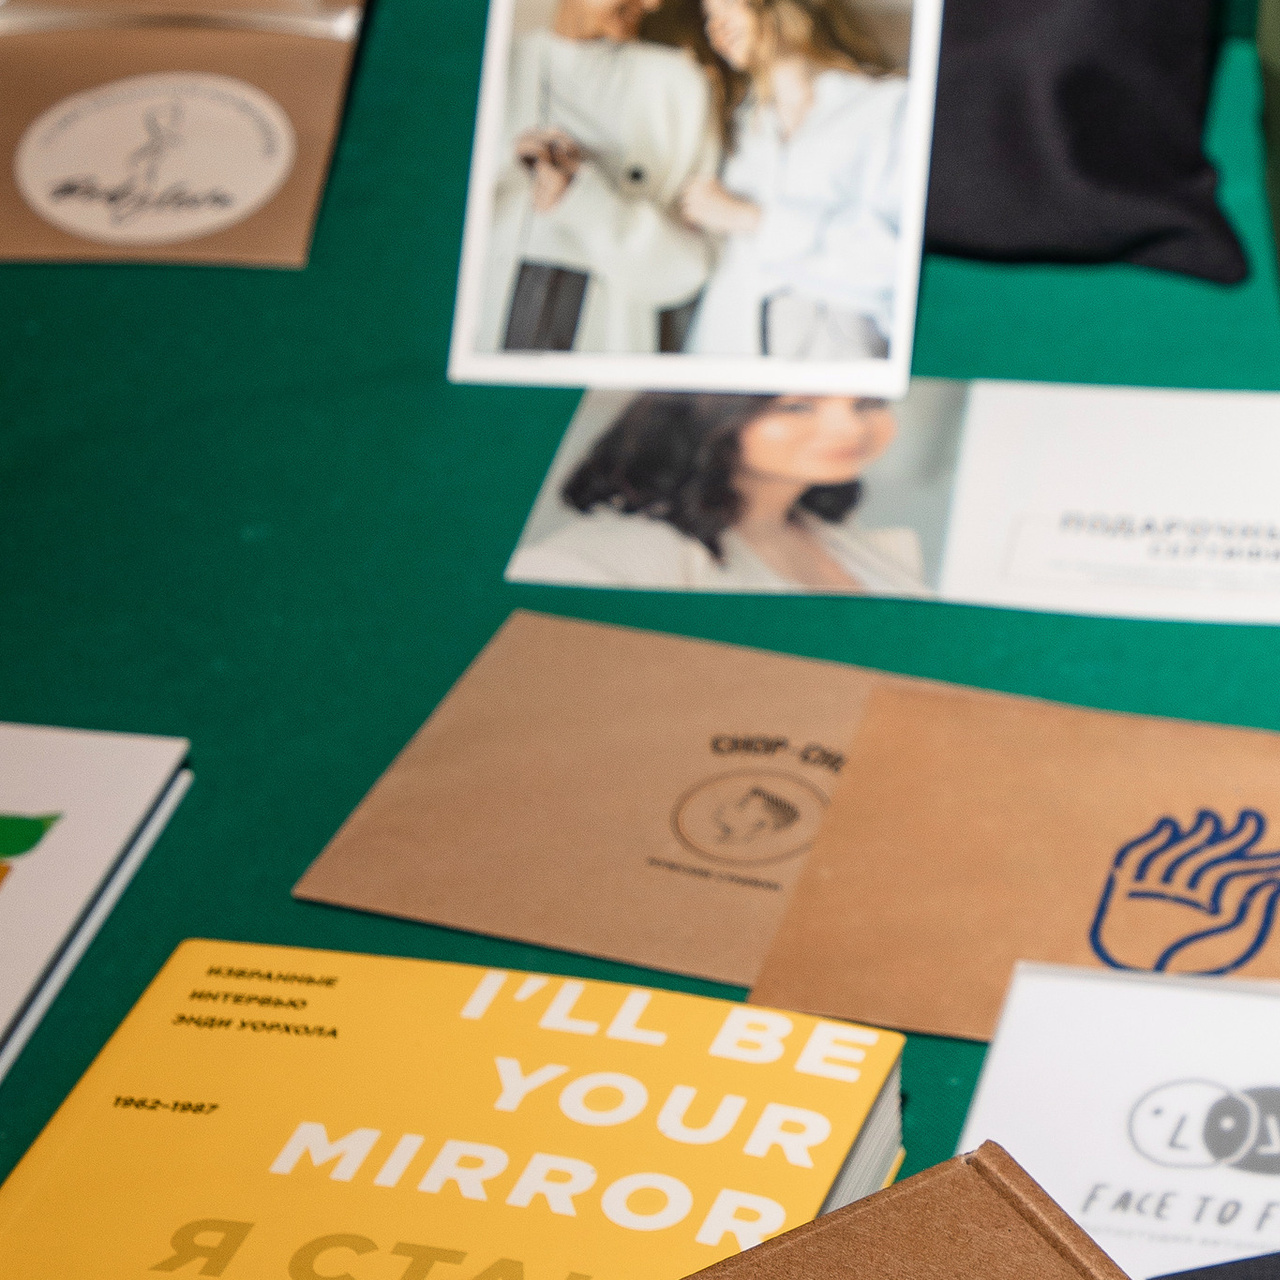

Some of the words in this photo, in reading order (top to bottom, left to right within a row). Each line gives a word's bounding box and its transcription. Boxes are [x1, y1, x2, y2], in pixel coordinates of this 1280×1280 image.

[188, 989, 309, 1011] ИНТЕРВЬЮ
[206, 965, 339, 988] ИЗБРАННЫЕ
[172, 1013, 233, 1030] ЭНДИ
[237, 1019, 338, 1040] УОРХОЛА
[708, 1006, 879, 1083] BE
[493, 1056, 833, 1169] YOUR
[268, 1120, 787, 1253] MIRROR
[1080, 1181, 1178, 1220] FACE
[1193, 1194, 1243, 1227] TO
[147, 1218, 255, 1278] Я
